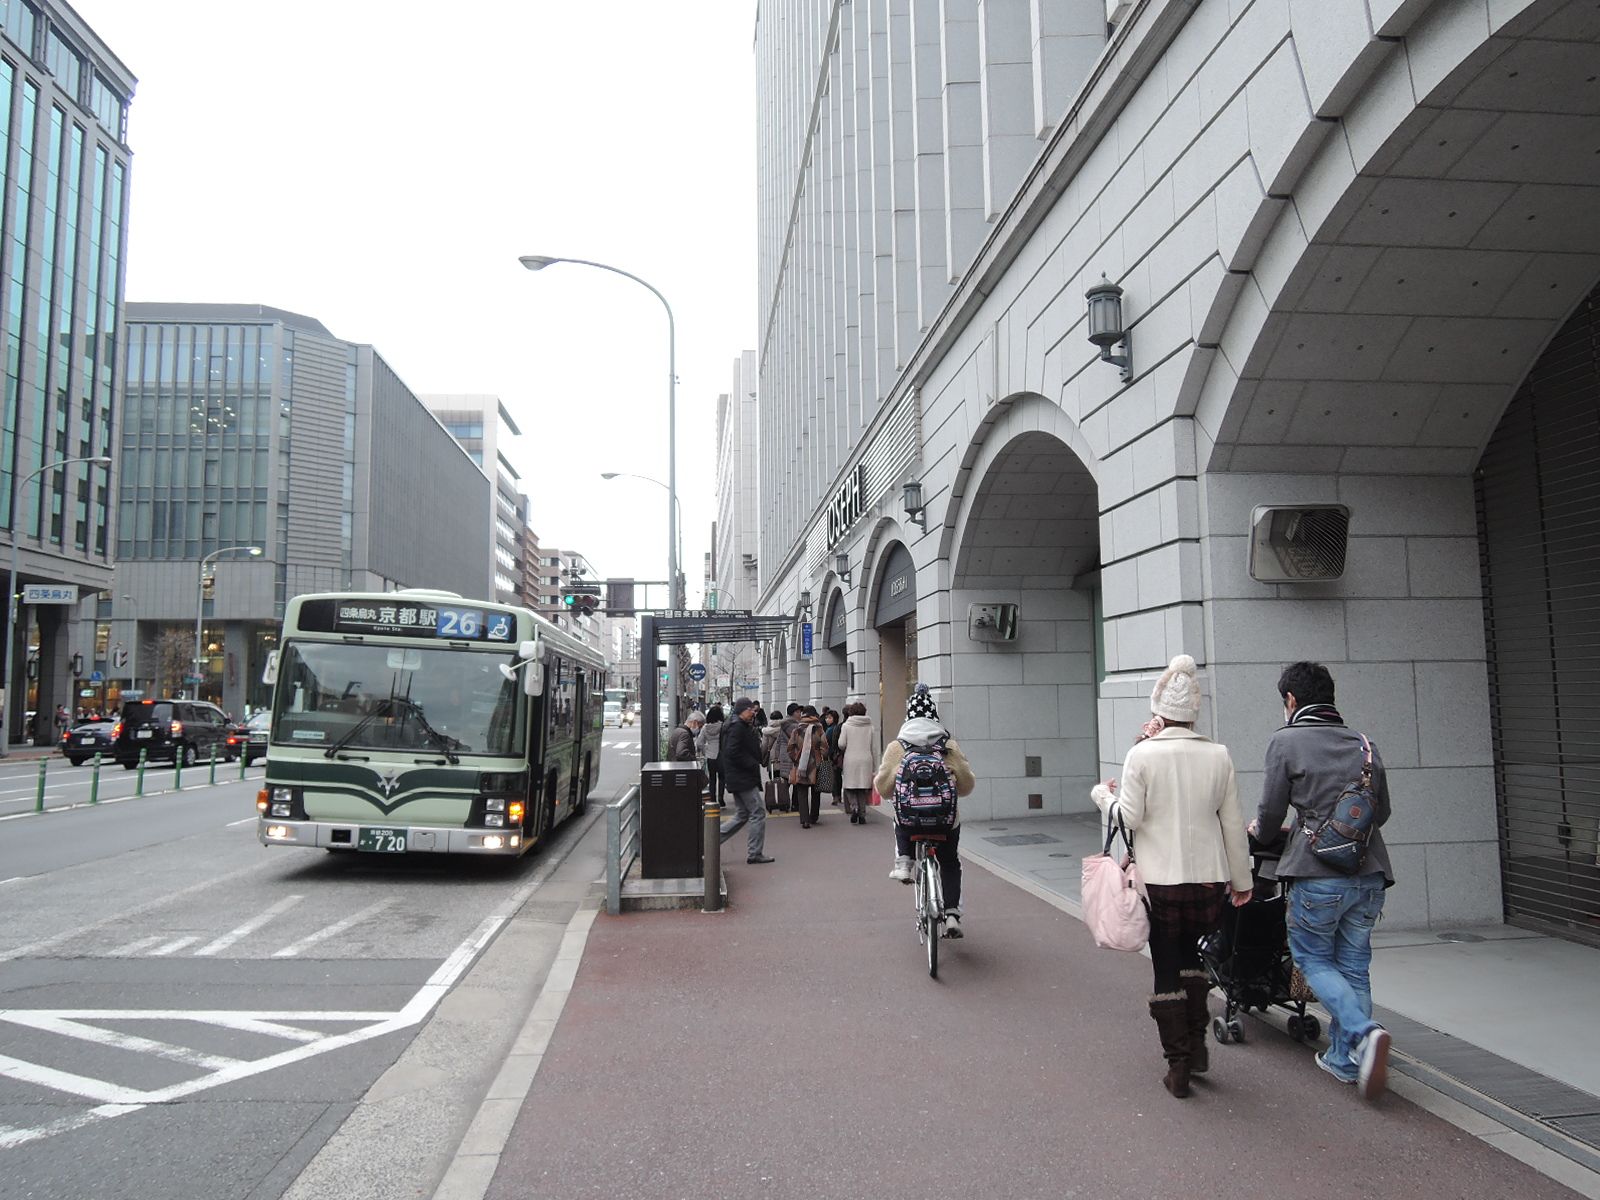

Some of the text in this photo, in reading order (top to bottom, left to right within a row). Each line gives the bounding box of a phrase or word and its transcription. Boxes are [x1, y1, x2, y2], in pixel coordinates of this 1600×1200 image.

[826, 463, 863, 550] JOSEPH
[378, 606, 437, 626] 京都駅
[441, 611, 477, 636] 26
